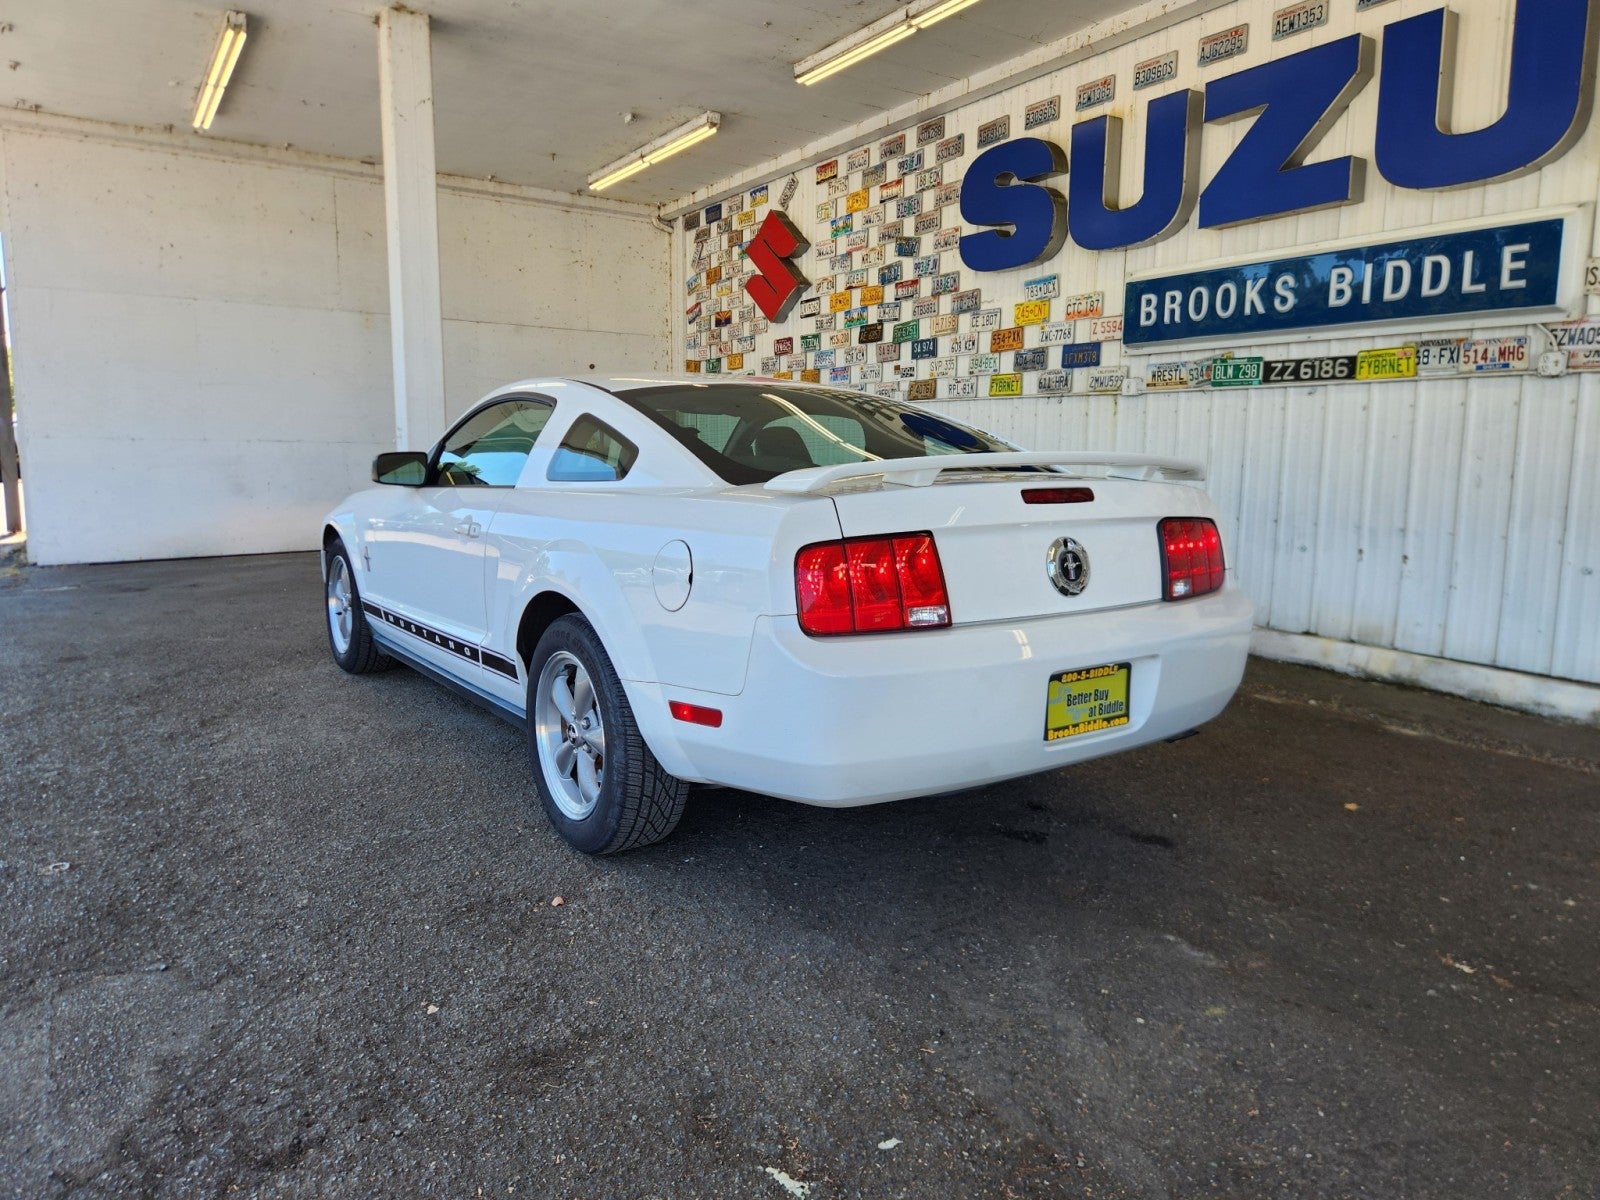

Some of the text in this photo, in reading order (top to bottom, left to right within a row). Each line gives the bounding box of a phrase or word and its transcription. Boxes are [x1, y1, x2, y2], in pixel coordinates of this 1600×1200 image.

[1275, 5, 1323, 36] AEW1353
[1135, 61, 1174, 86] B30960S
[960, 0, 1587, 271] SUZU
[1140, 243, 1530, 327] BROOKS BIDDLE
[1101, 320, 1122, 334] 5594
[1463, 346, 1524, 364] 514 MHG
[1152, 368, 1184, 382] WRESTL
[1239, 364, 1257, 378] 298
[1270, 359, 1348, 381] ZZ 6186
[1359, 358, 1411, 375] FYBRNET
[388, 614, 471, 656] MUSTANG
[1066, 688, 1109, 707] Better Buy
[1088, 700, 1124, 718] at Biddle
[1047, 716, 1128, 740] BrooksBiddle.com
